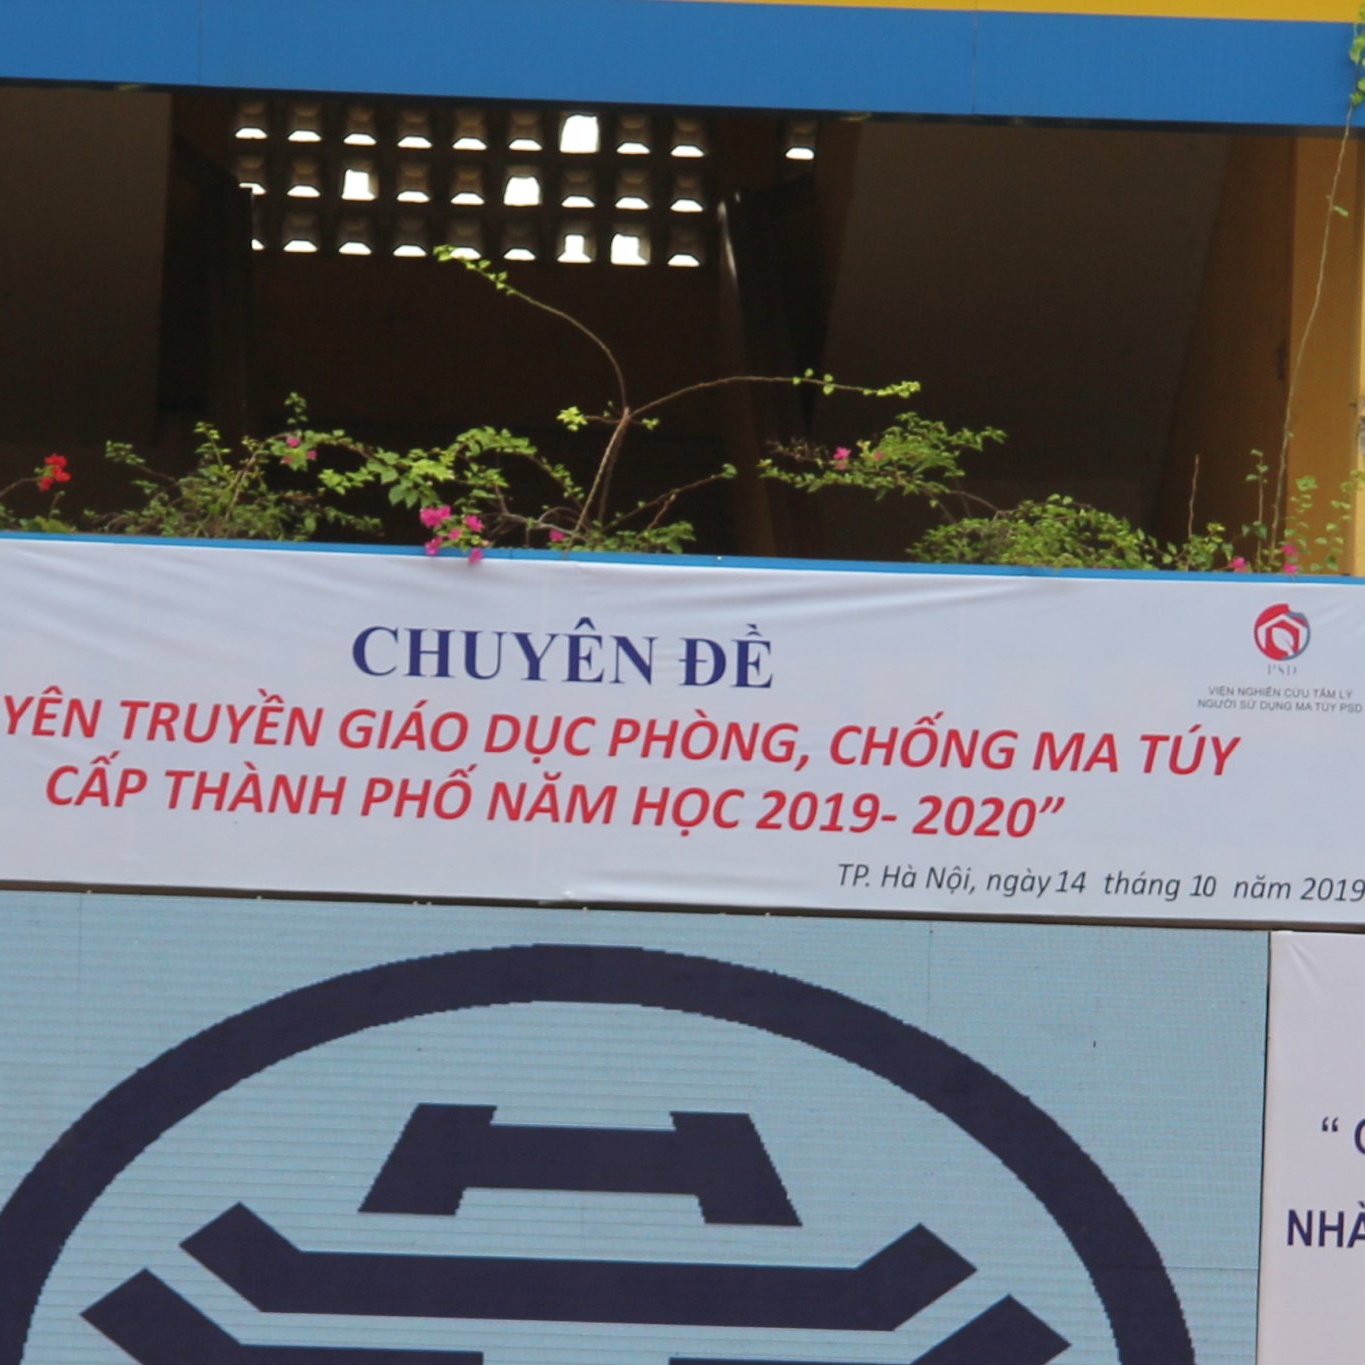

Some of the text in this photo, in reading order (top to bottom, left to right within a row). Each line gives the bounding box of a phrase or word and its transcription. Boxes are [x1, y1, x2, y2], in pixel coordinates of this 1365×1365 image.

[353, 617, 772, 688] CHUYÊN ĐỀ
[112, 688, 324, 748] TRUYỀN
[339, 700, 469, 752] GIÁO
[485, 714, 596, 765] DỤC
[609, 710, 809, 771] PHÒNG,
[831, 712, 1019, 770] CHỐNG
[1034, 731, 1118, 772] MA
[1141, 724, 1241, 775] TÚY
[1294, 701, 1313, 712] MA
[1339, 703, 1364, 714] PSD
[47, 752, 1065, 838] CẤP THÀNH PHỐ NĂM HỌC 2019- 2020”
[839, 864, 1365, 901] TP. Hà Nội, ngày 14 tháng 10 năm 2019
